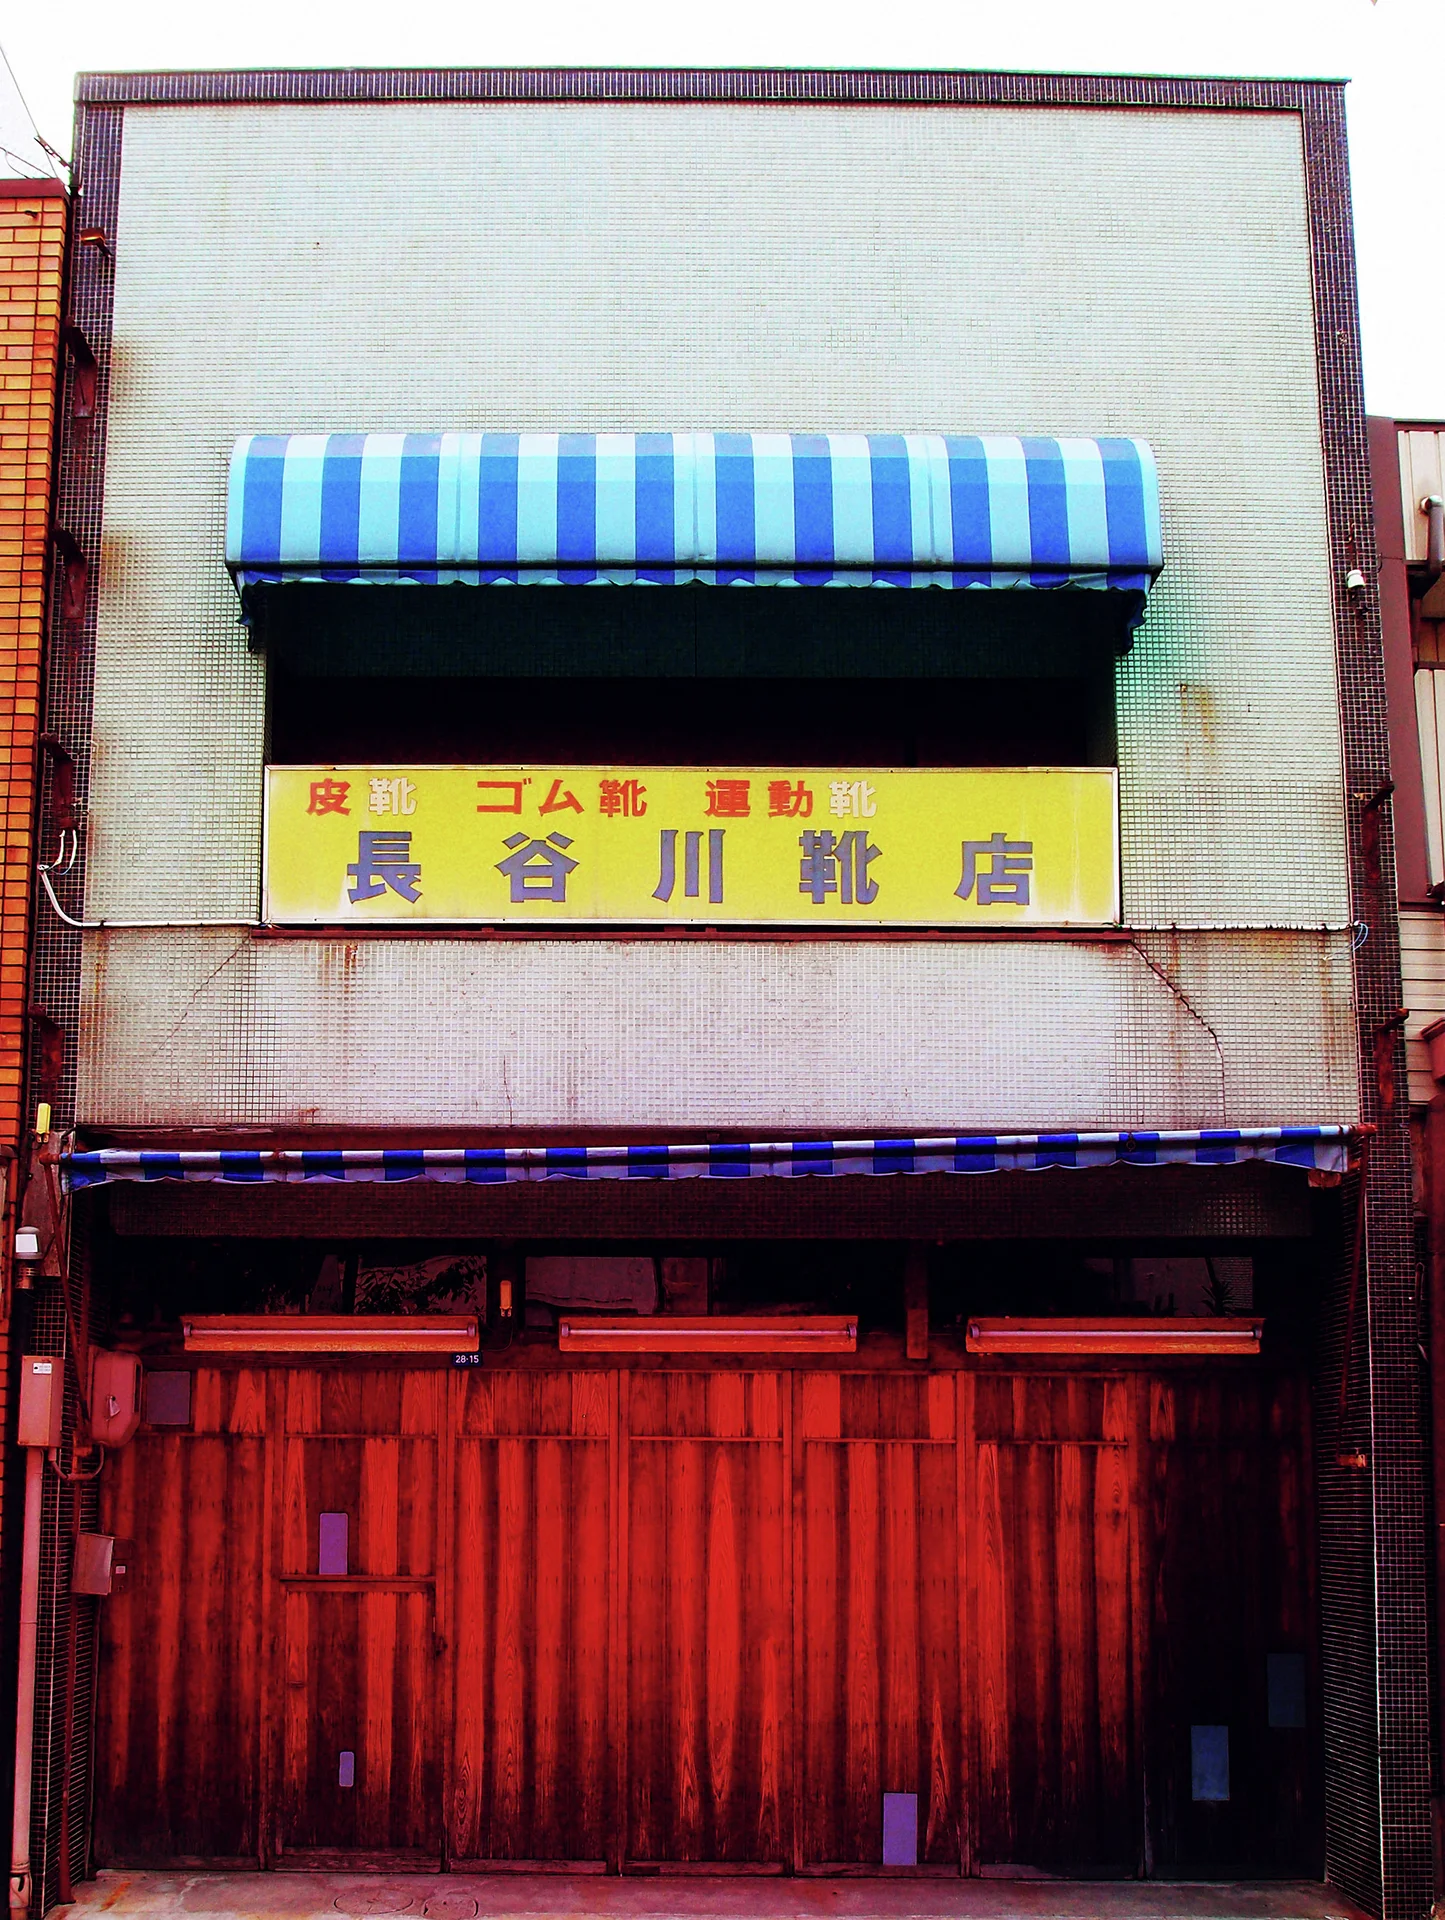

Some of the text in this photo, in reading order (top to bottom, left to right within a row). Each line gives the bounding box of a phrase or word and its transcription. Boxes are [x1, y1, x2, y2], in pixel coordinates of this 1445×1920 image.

[305, 778, 877, 818] 皮靴 ゴム靴 運動靴
[346, 829, 1034, 906] 長谷川靴店
